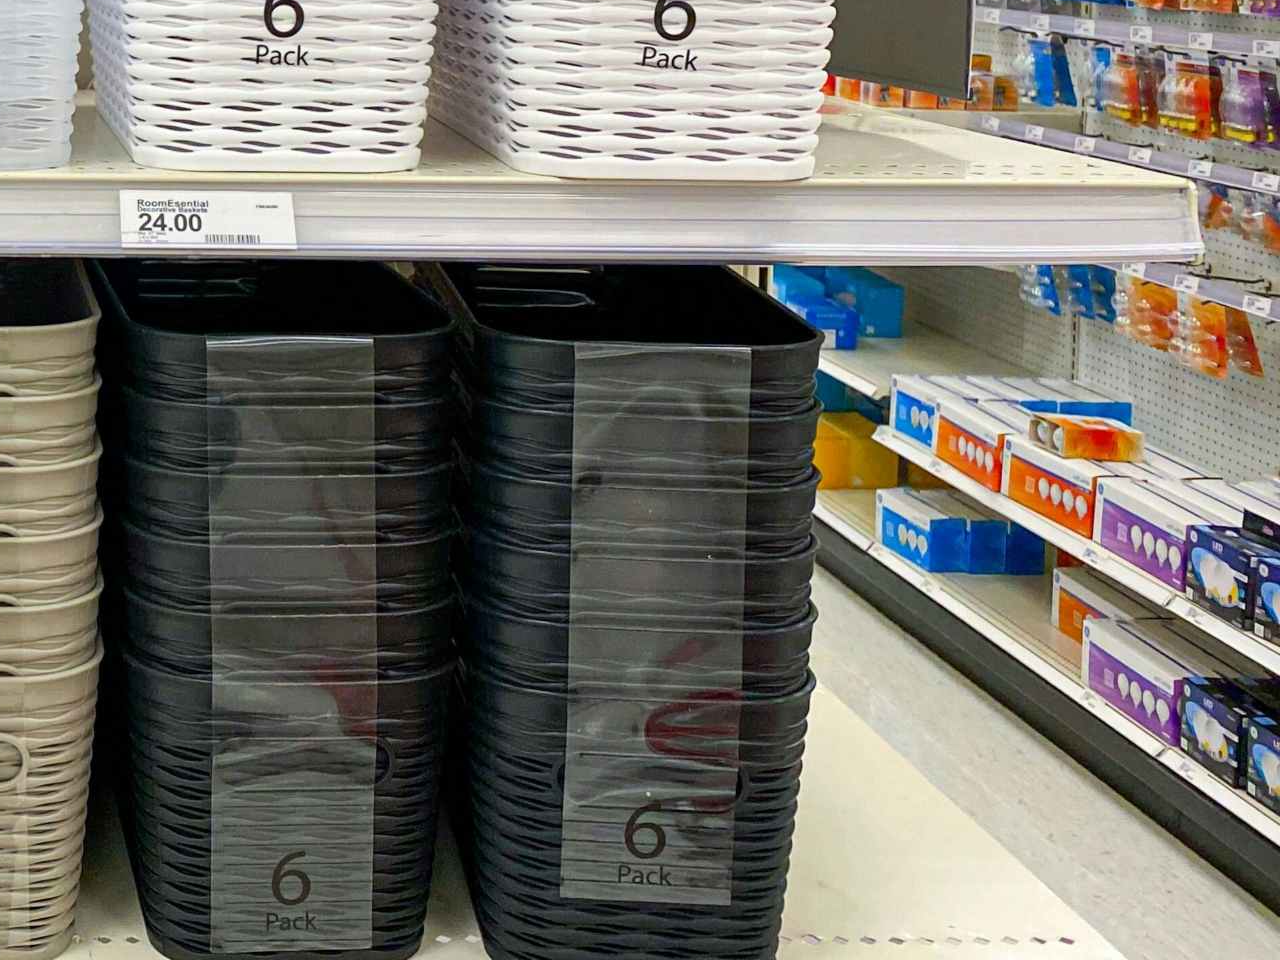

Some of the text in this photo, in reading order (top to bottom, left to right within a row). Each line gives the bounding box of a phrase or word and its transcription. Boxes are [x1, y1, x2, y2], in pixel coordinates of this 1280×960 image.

[254, 43, 310, 66] Pack
[640, 46, 698, 71] Pack
[138, 213, 203, 232] 24.00
[624, 801, 667, 859] 6
[271, 850, 312, 906] 6
[617, 864, 673, 891] Pack
[265, 911, 318, 933] Pack
